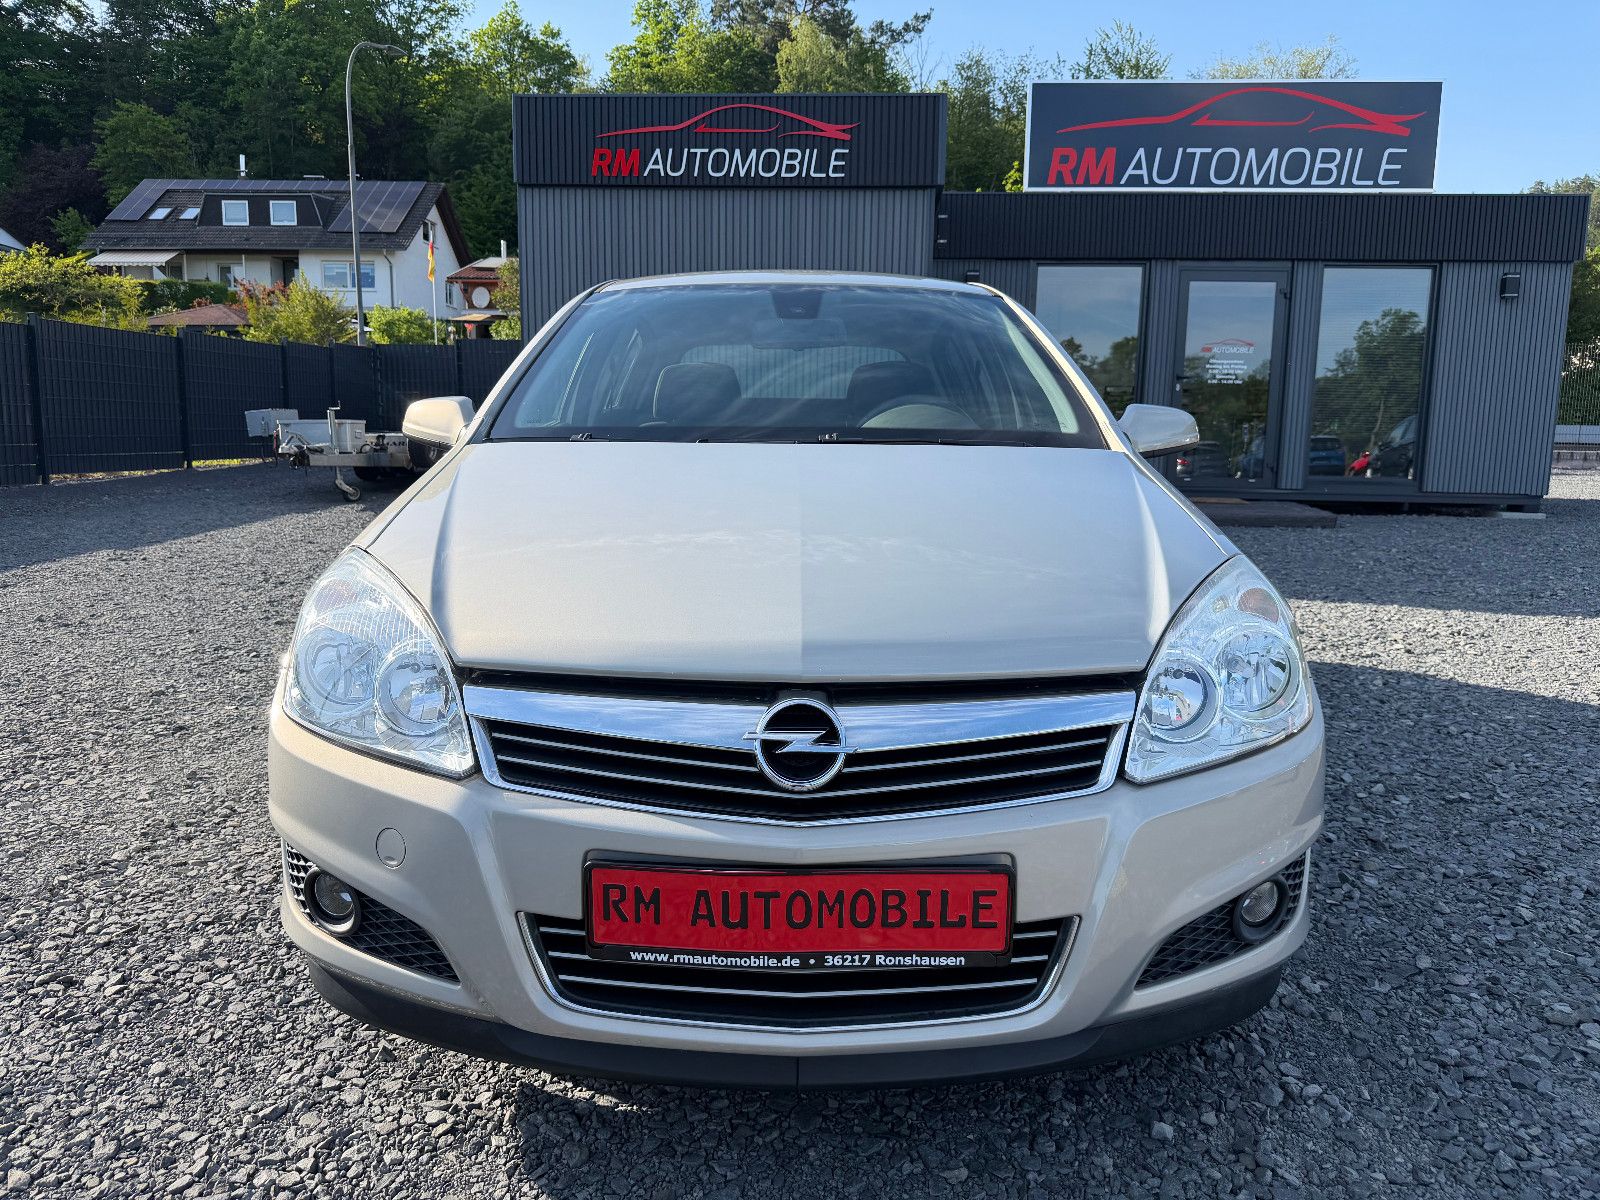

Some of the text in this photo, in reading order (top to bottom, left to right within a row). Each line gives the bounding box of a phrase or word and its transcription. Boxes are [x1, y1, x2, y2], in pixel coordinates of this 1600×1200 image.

[591, 148, 849, 178] RM AUTOMOBILE
[1046, 147, 1408, 186] RM AUTOMOBILE
[602, 884, 998, 930] RM AUTOMOBILE
[629, 950, 966, 968] www.rmautomobile.de 36217 Ronshausen
